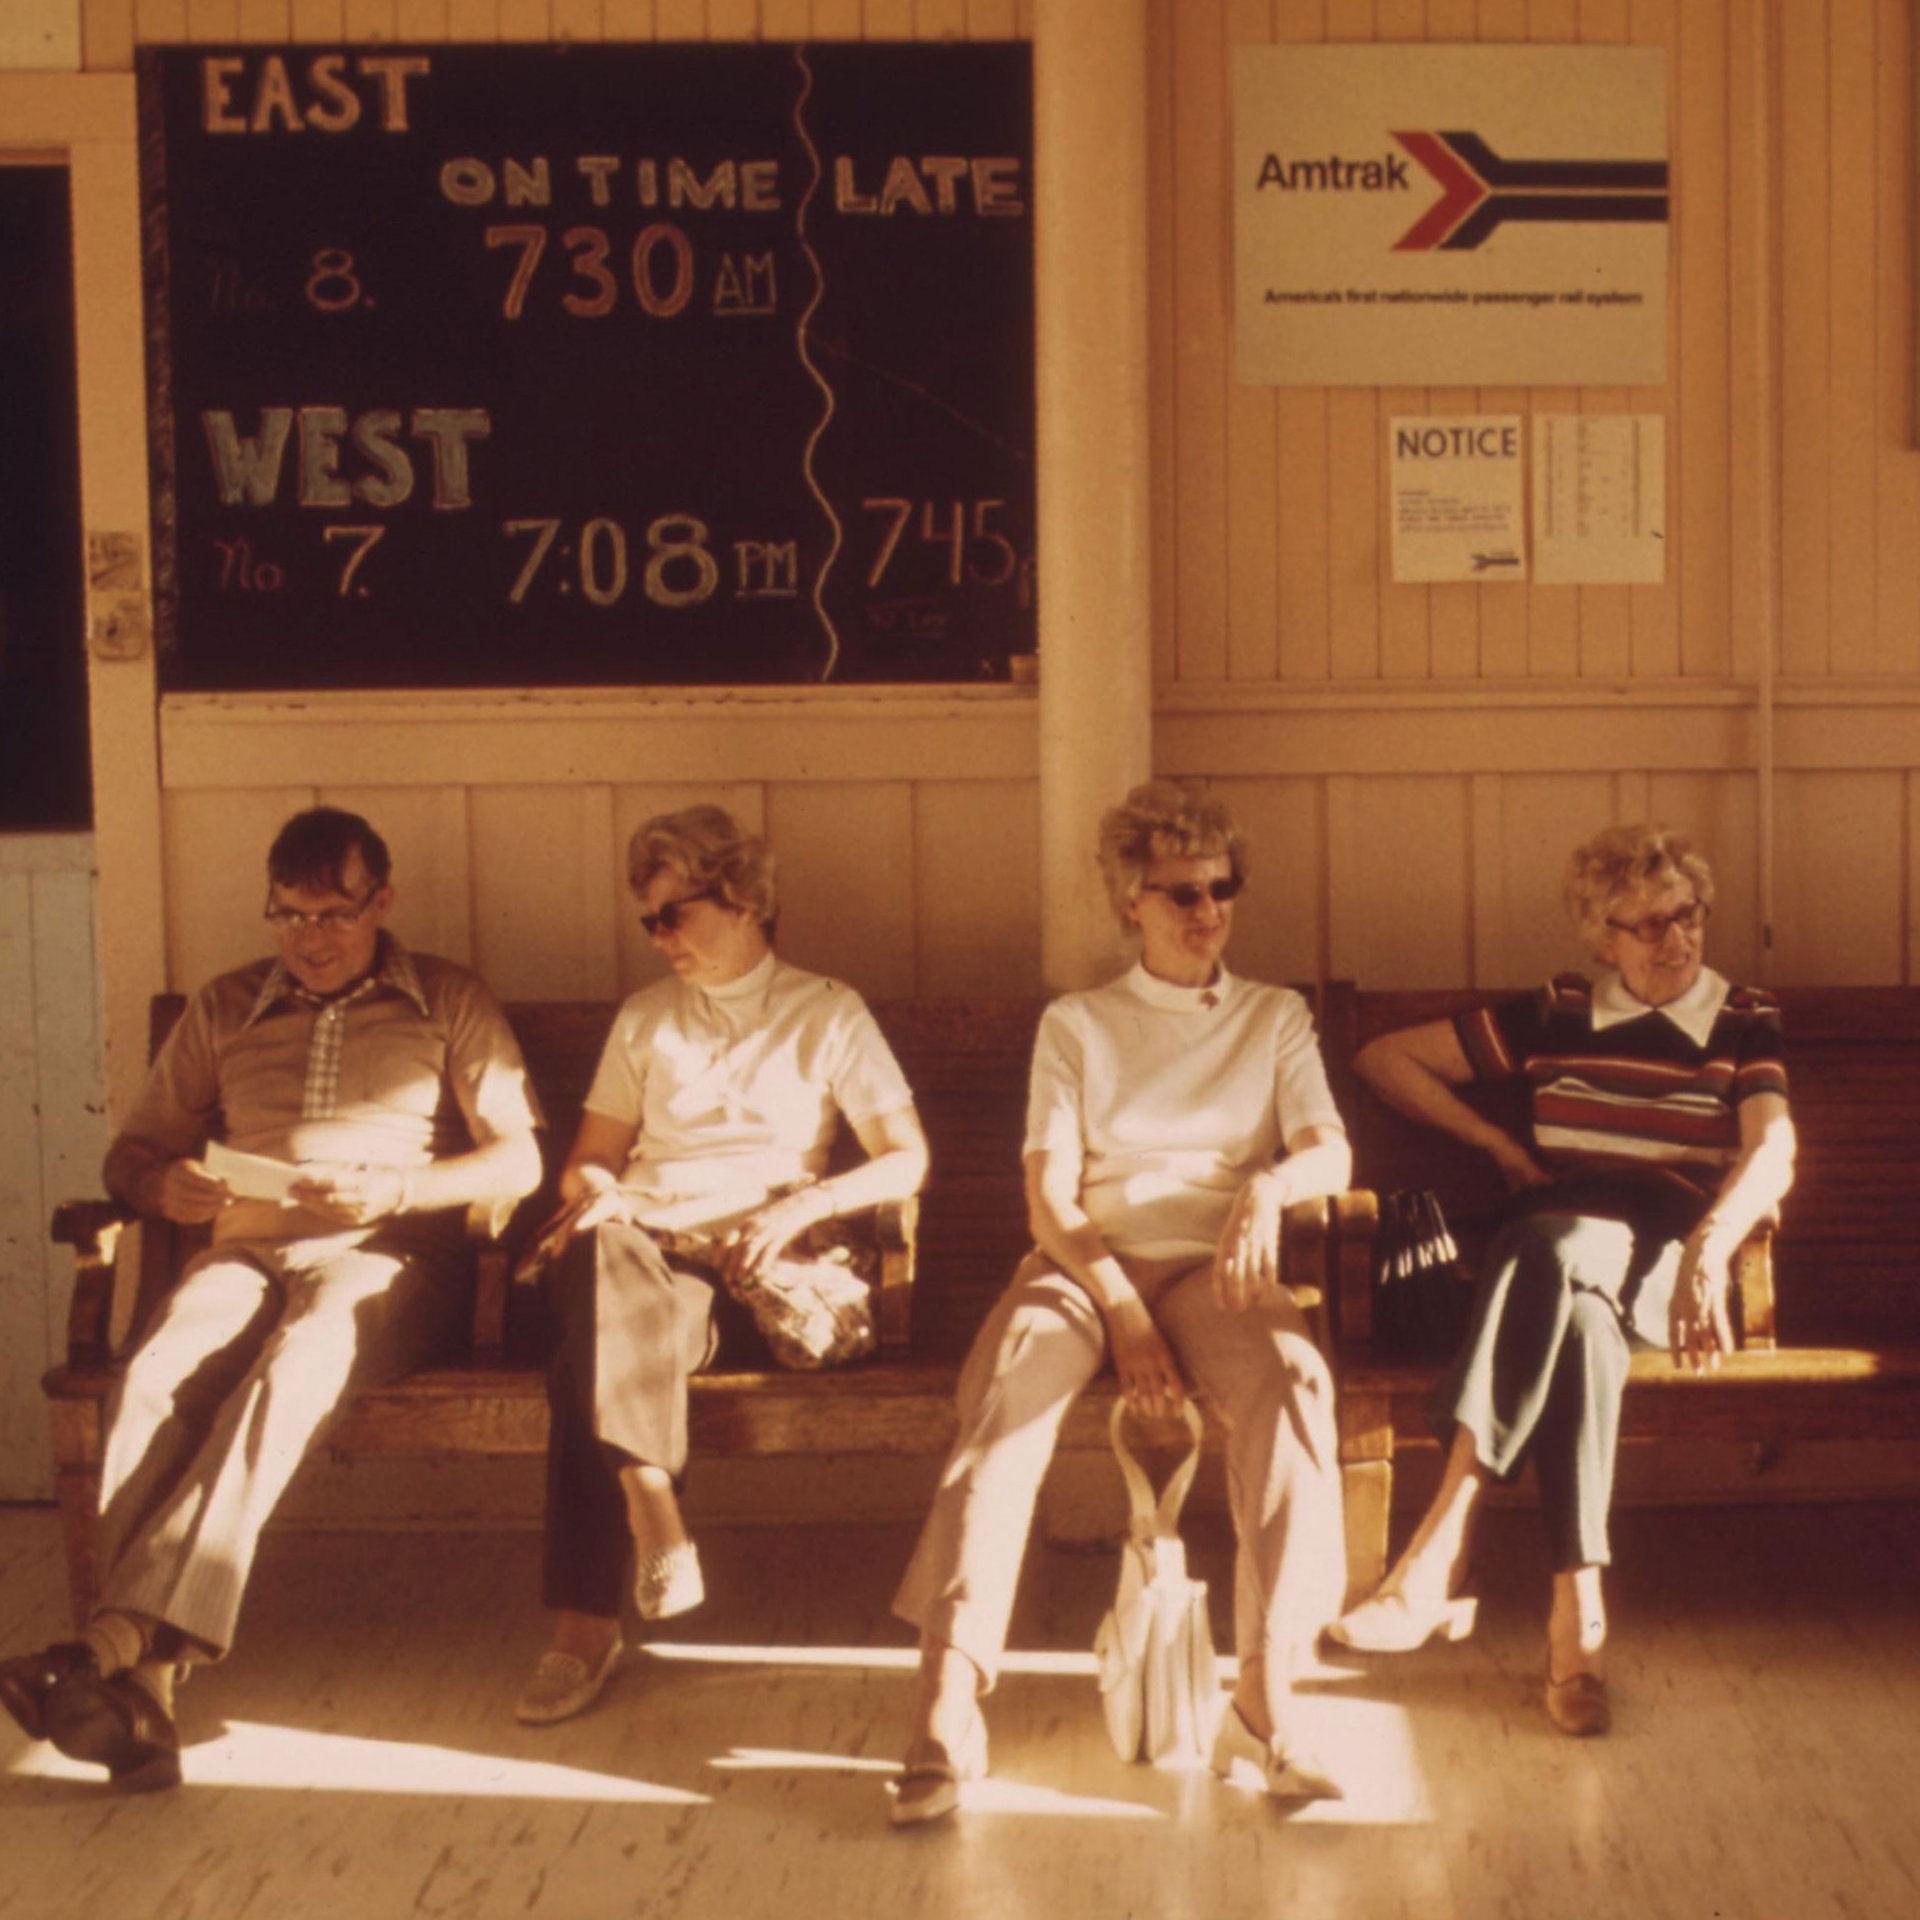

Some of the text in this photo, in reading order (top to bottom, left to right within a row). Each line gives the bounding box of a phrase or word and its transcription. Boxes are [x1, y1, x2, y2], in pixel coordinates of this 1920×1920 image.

[205, 55, 432, 133] EAST
[439, 156, 781, 211] ON TIME
[834, 155, 1023, 216] LATE
[1256, 154, 1410, 192] Amtrak
[485, 223, 695, 319] 730
[713, 251, 777, 314] AM
[1346, 288, 1377, 304] first
[1380, 288, 1469, 304] nationwide
[1472, 290, 1555, 308] passenger
[1559, 289, 1583, 304] rail
[1586, 290, 1643, 308] system
[202, 406, 491, 510] WEST
[1396, 427, 1518, 458] NOTICE
[502, 512, 720, 607] 7:08
[733, 539, 798, 592] PM
